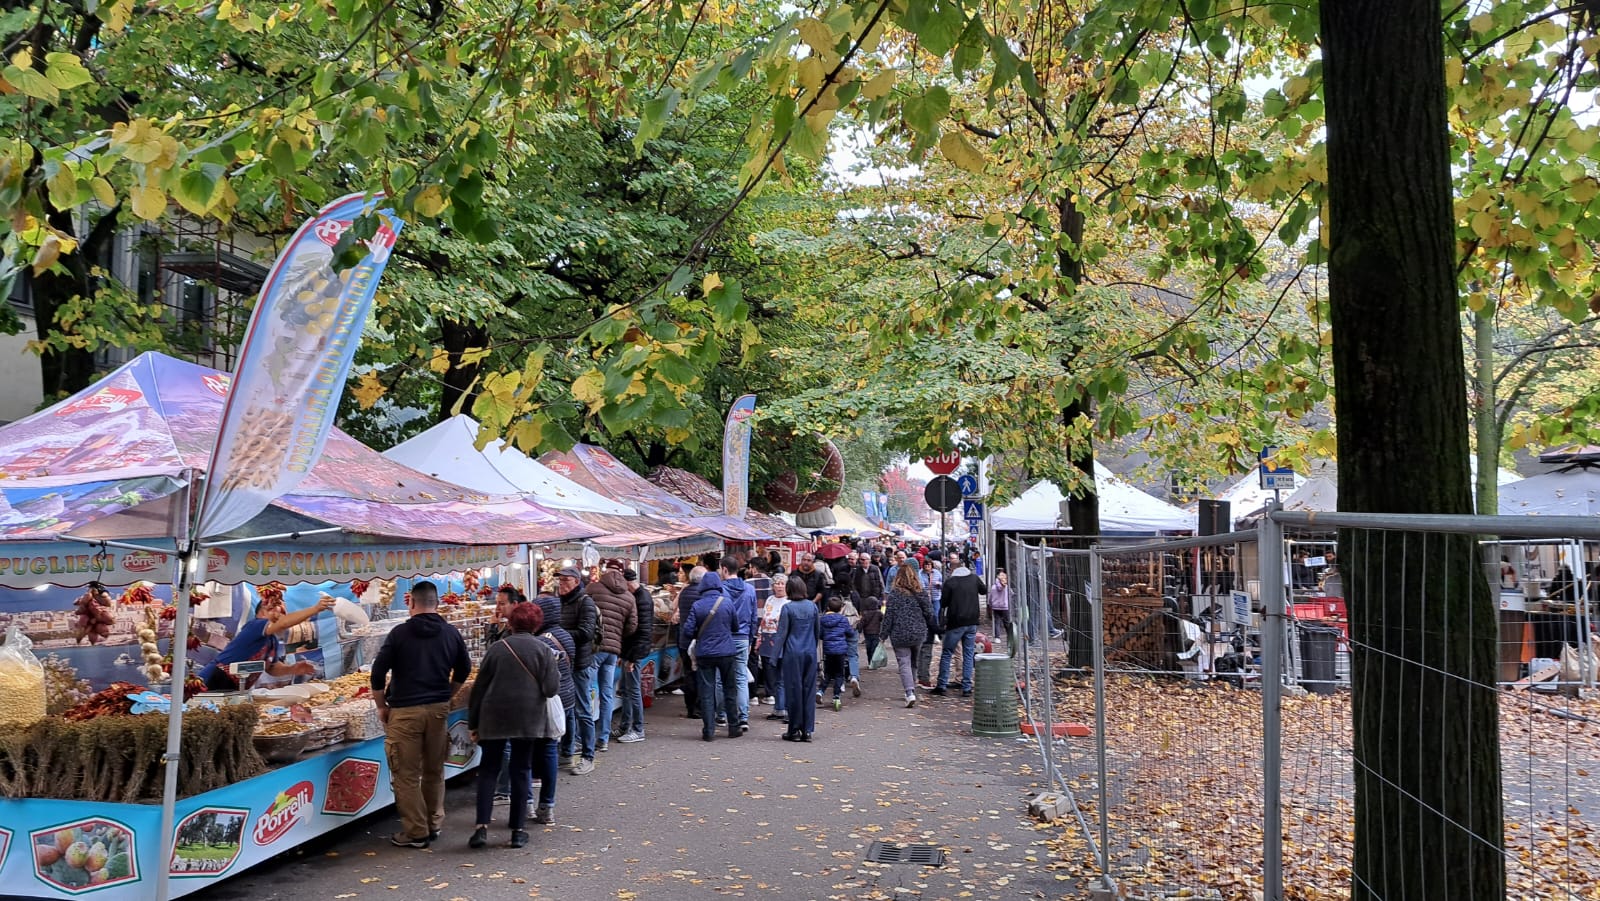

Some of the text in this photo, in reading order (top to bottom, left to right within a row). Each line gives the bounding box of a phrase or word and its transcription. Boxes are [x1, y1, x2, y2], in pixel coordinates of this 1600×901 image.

[0, 553, 115, 576] PUGLIESI
[123, 553, 164, 567] Porrelli
[384, 549, 434, 572] OLIVE
[255, 787, 309, 840] Porrelli
